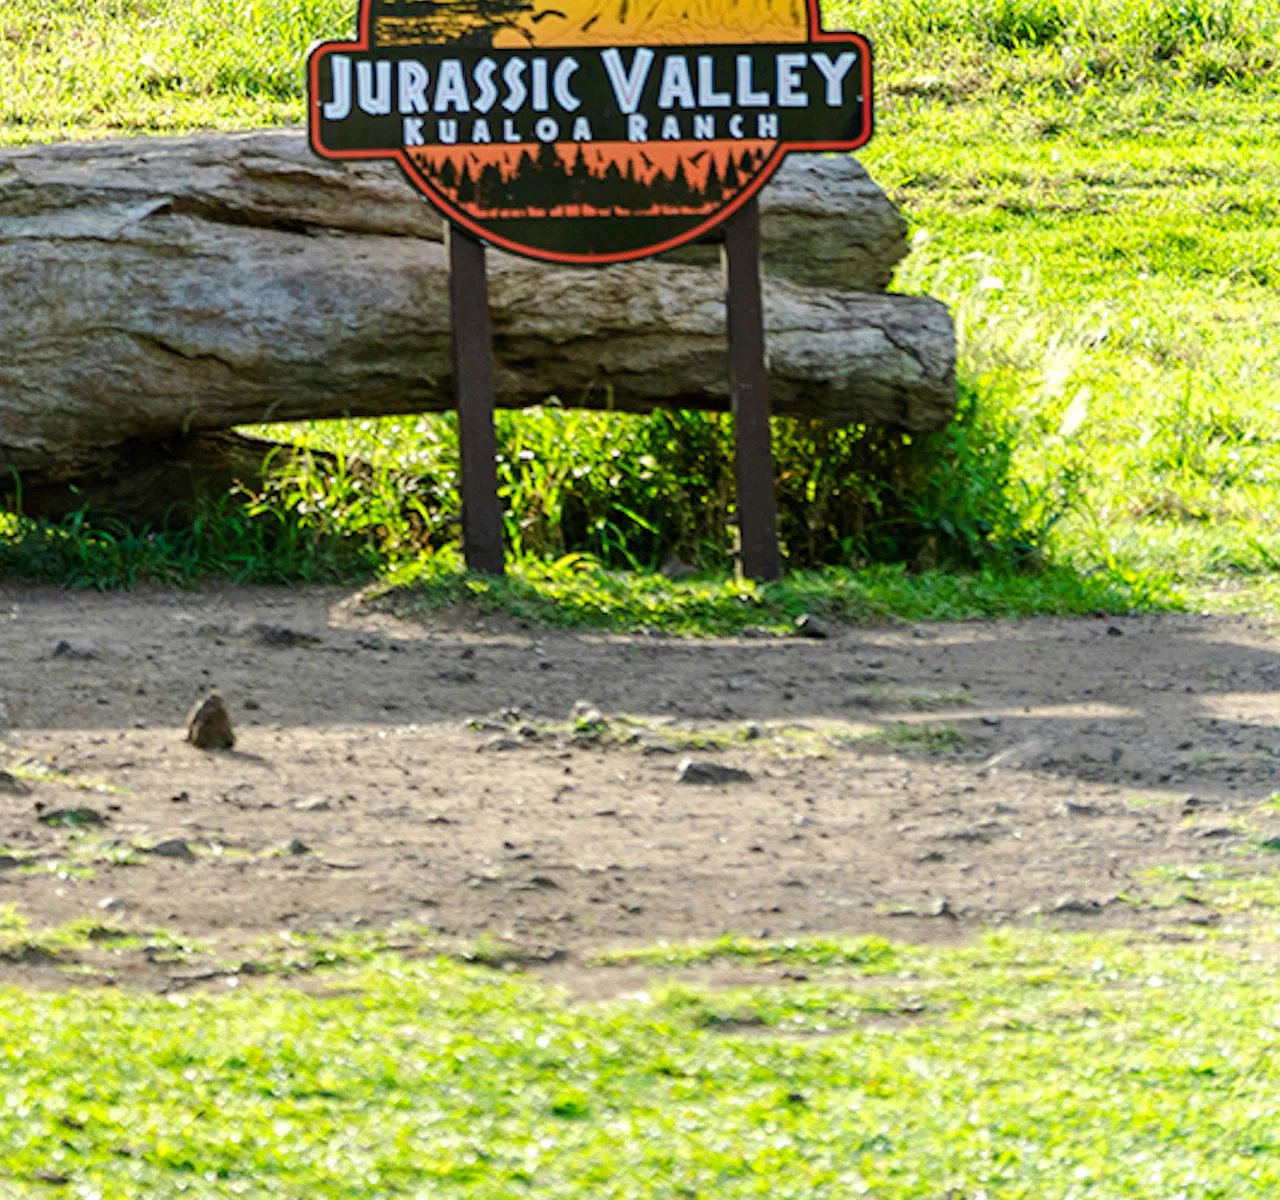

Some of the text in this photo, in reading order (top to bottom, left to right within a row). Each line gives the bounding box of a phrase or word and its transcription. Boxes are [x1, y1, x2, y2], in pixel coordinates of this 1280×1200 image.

[323, 47, 856, 120] JURASSIC VALLEY
[403, 112, 780, 146] KUALOA RANCH
